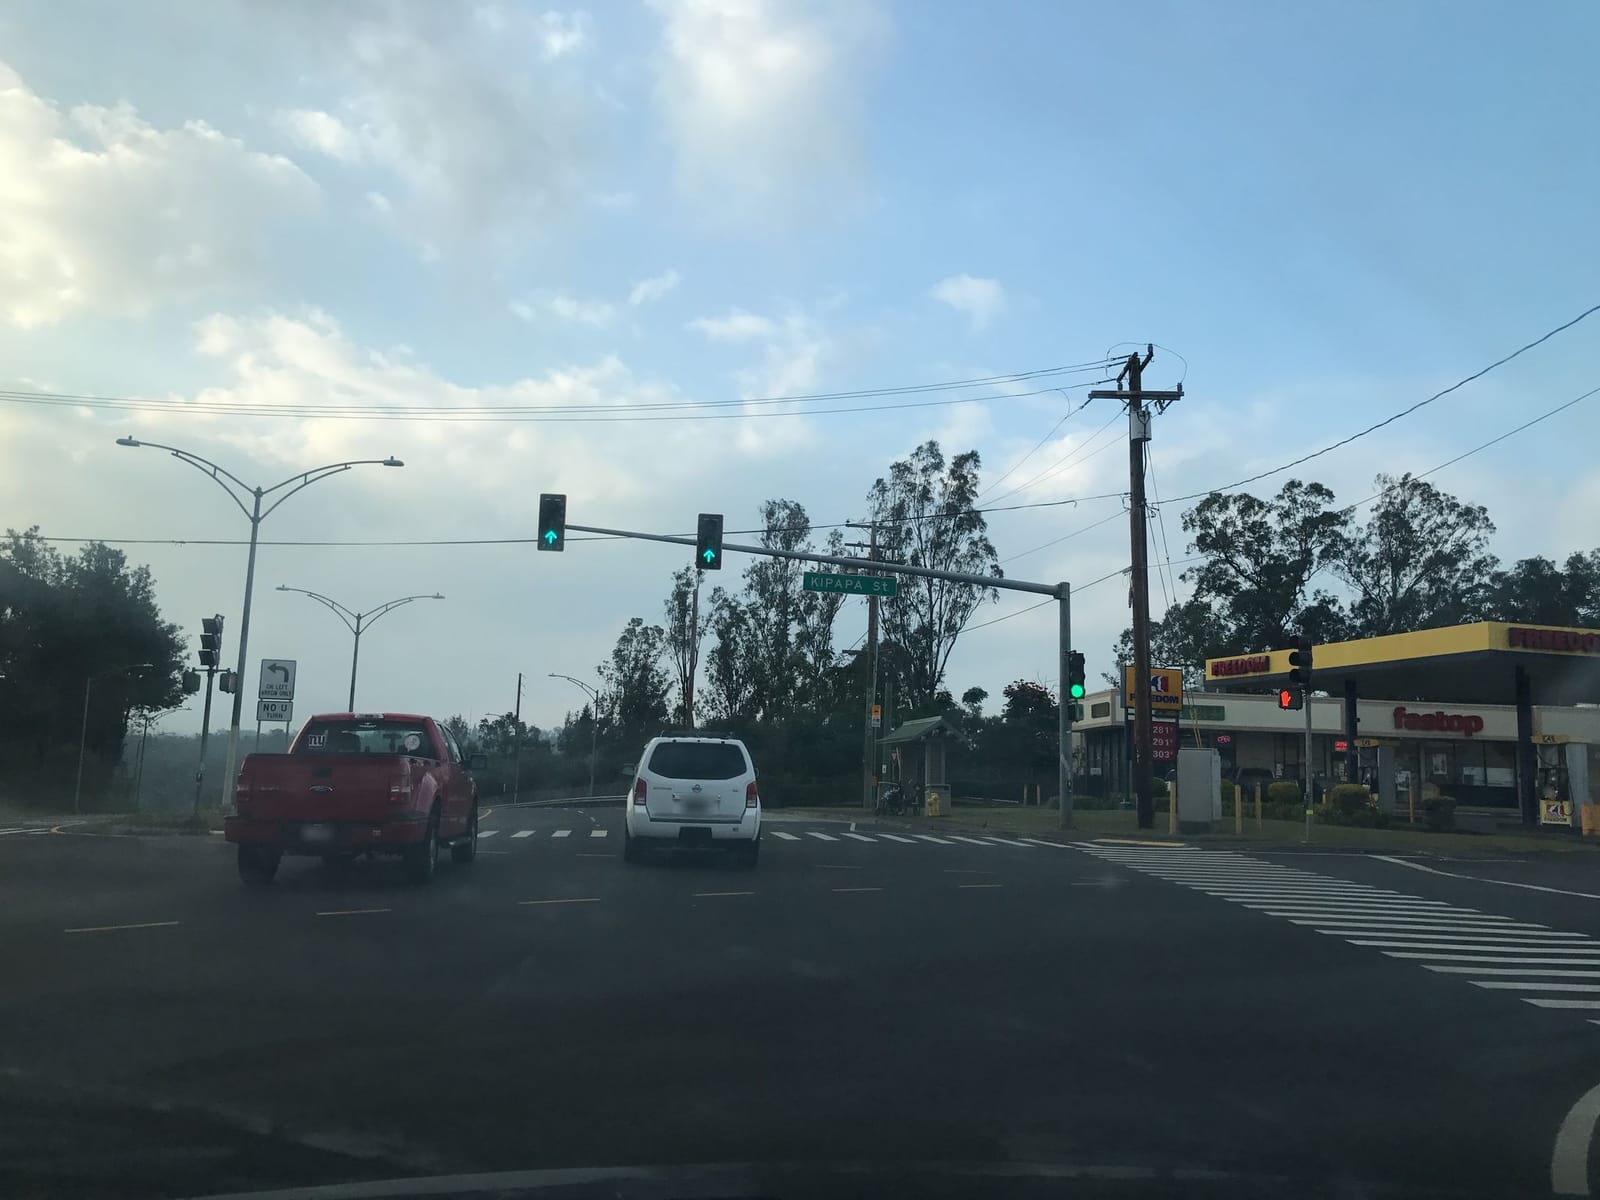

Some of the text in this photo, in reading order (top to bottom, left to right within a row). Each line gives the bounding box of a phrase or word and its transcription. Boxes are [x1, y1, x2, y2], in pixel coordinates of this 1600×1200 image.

[811, 577, 889, 592] KIPAPA St
[1508, 627, 1600, 652] FREEDO
[1211, 656, 1269, 677] FREEDOM
[1129, 692, 1179, 704] FEDOM
[263, 703, 288, 712] NO U
